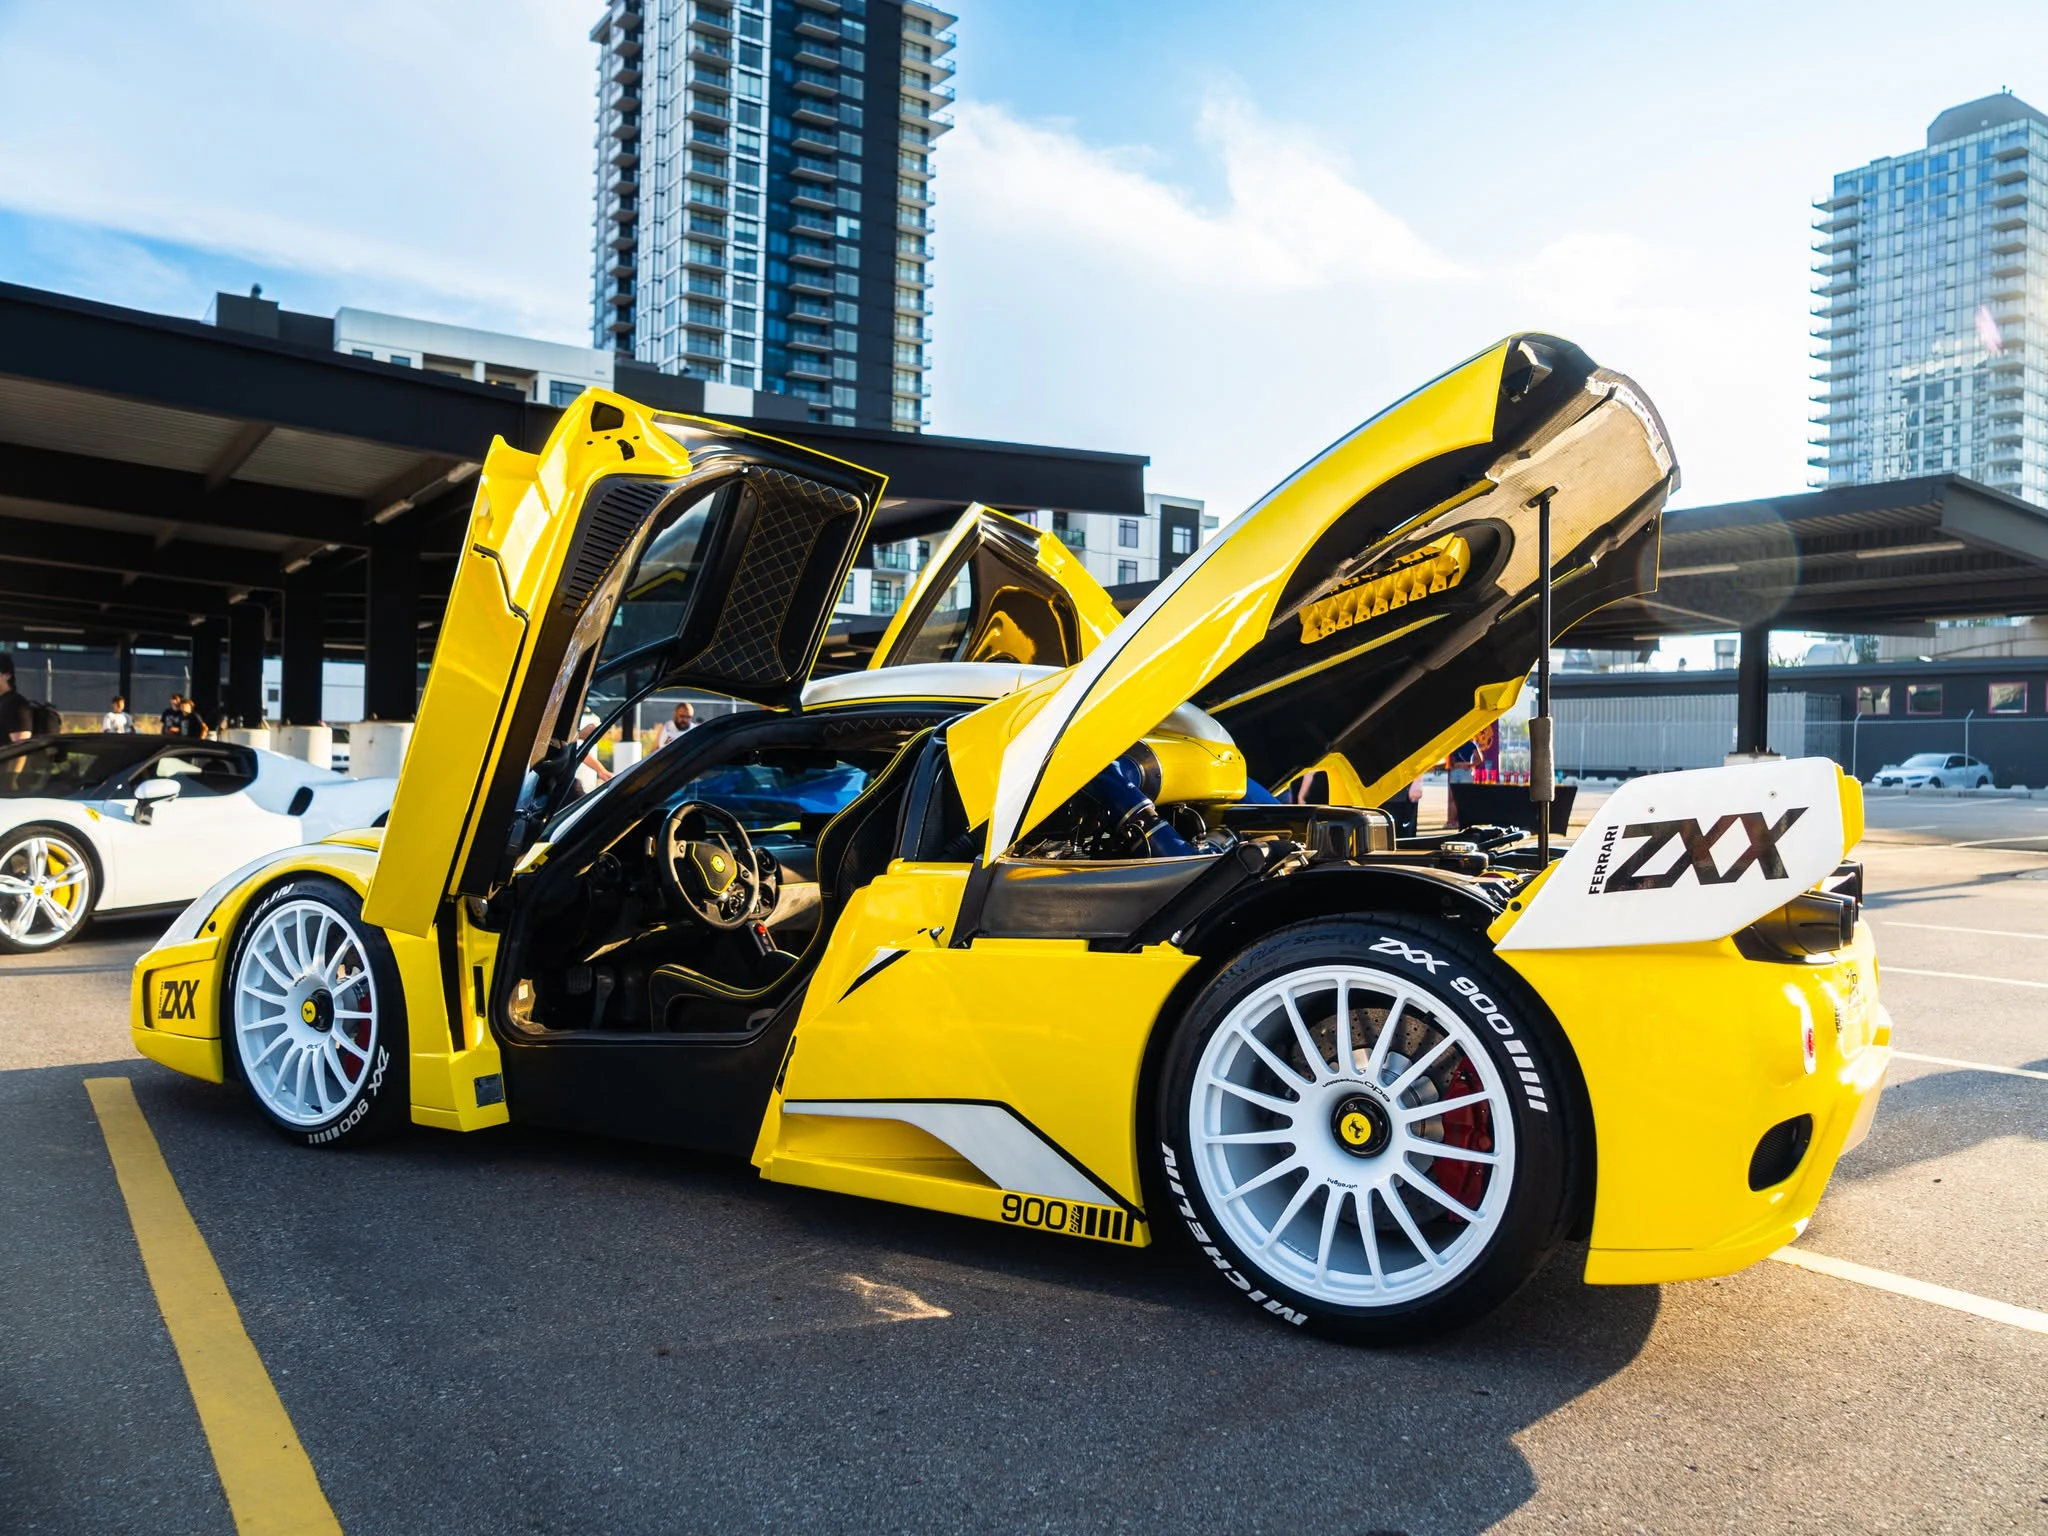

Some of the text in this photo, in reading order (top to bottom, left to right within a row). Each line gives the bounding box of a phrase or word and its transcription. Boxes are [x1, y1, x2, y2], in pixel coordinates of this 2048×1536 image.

[1588, 825, 1619, 895] FERRARI
[1603, 806, 1810, 894] ZXX
[160, 979, 200, 1019] ZXX
[1368, 936, 1514, 1035] ZXX 900
[341, 1045, 390, 1132] ZXX 900
[1001, 1194, 1080, 1233] 900 BHP
[1161, 1142, 1308, 1325] MICHELIN
